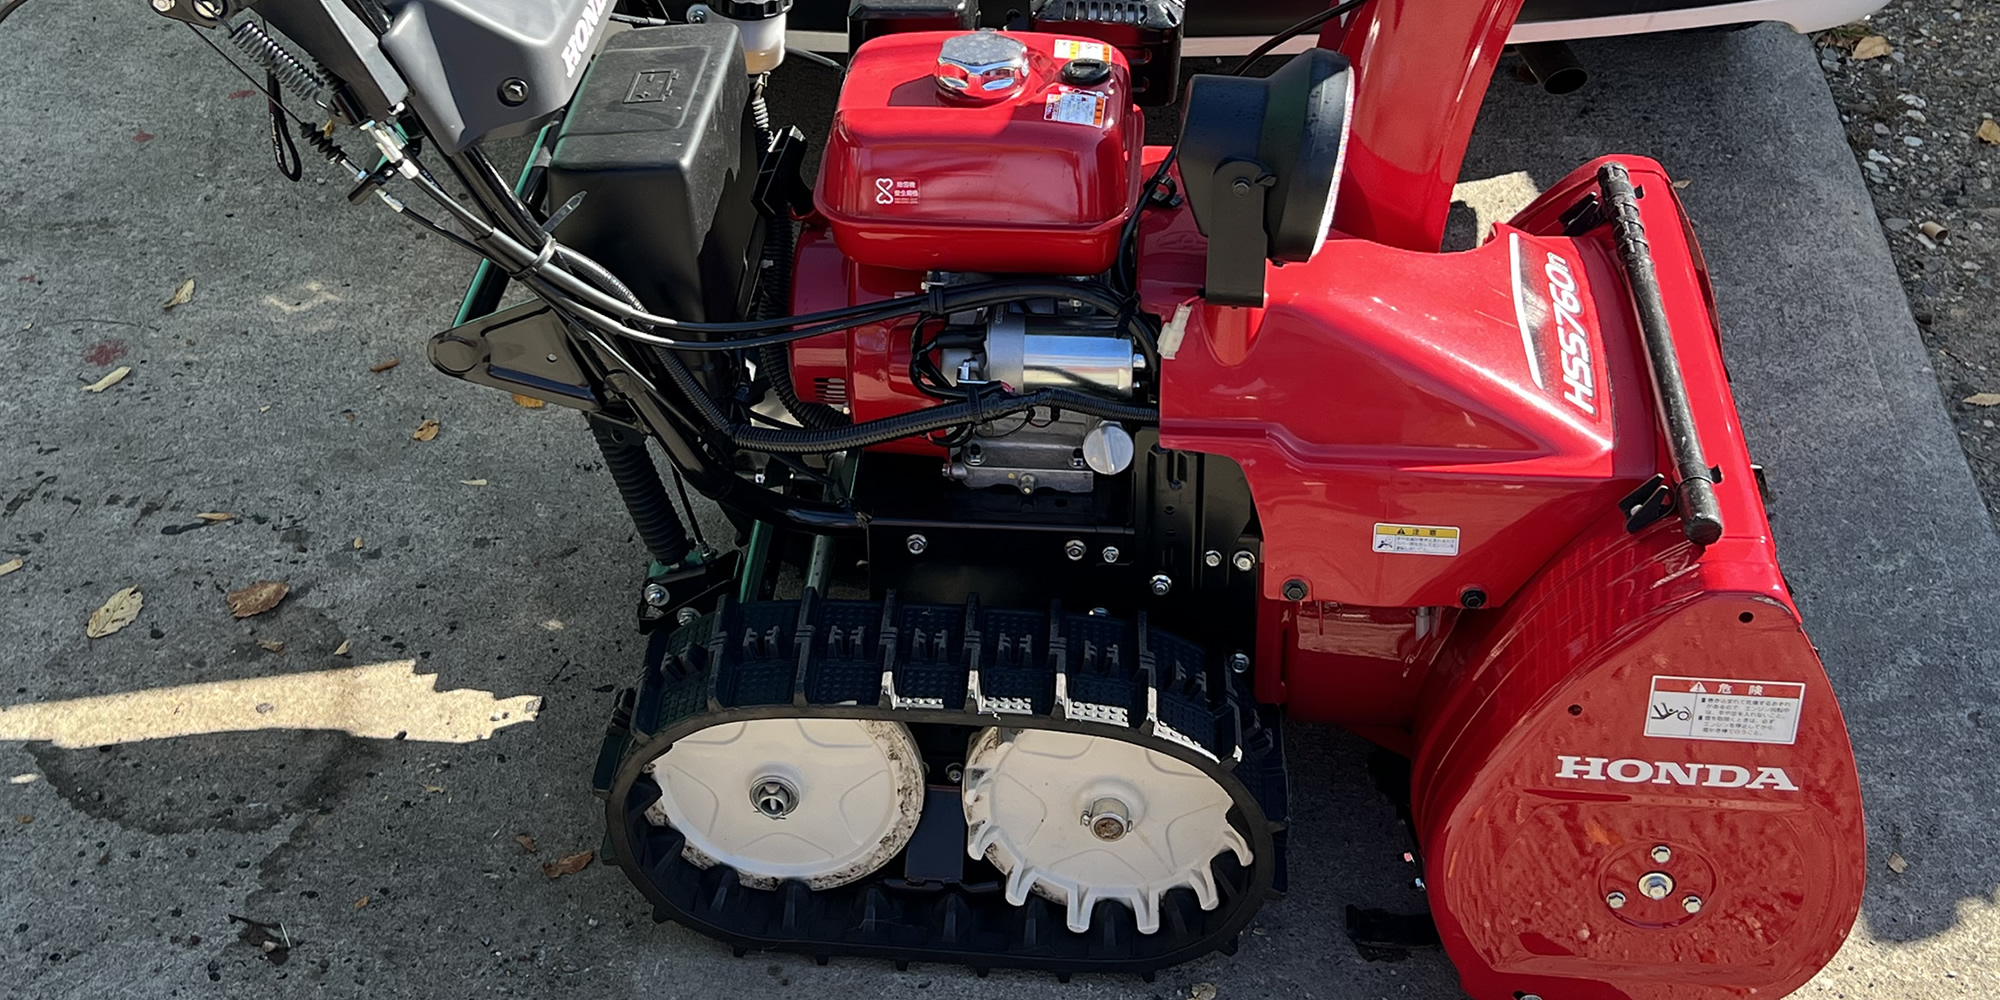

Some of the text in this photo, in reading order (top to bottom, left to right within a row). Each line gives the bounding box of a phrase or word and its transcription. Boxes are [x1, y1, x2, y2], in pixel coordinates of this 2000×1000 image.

[1545, 251, 1597, 415] HSS760n
[1717, 683, 1764, 696] 危険
[1555, 755, 1799, 791] HONDA
